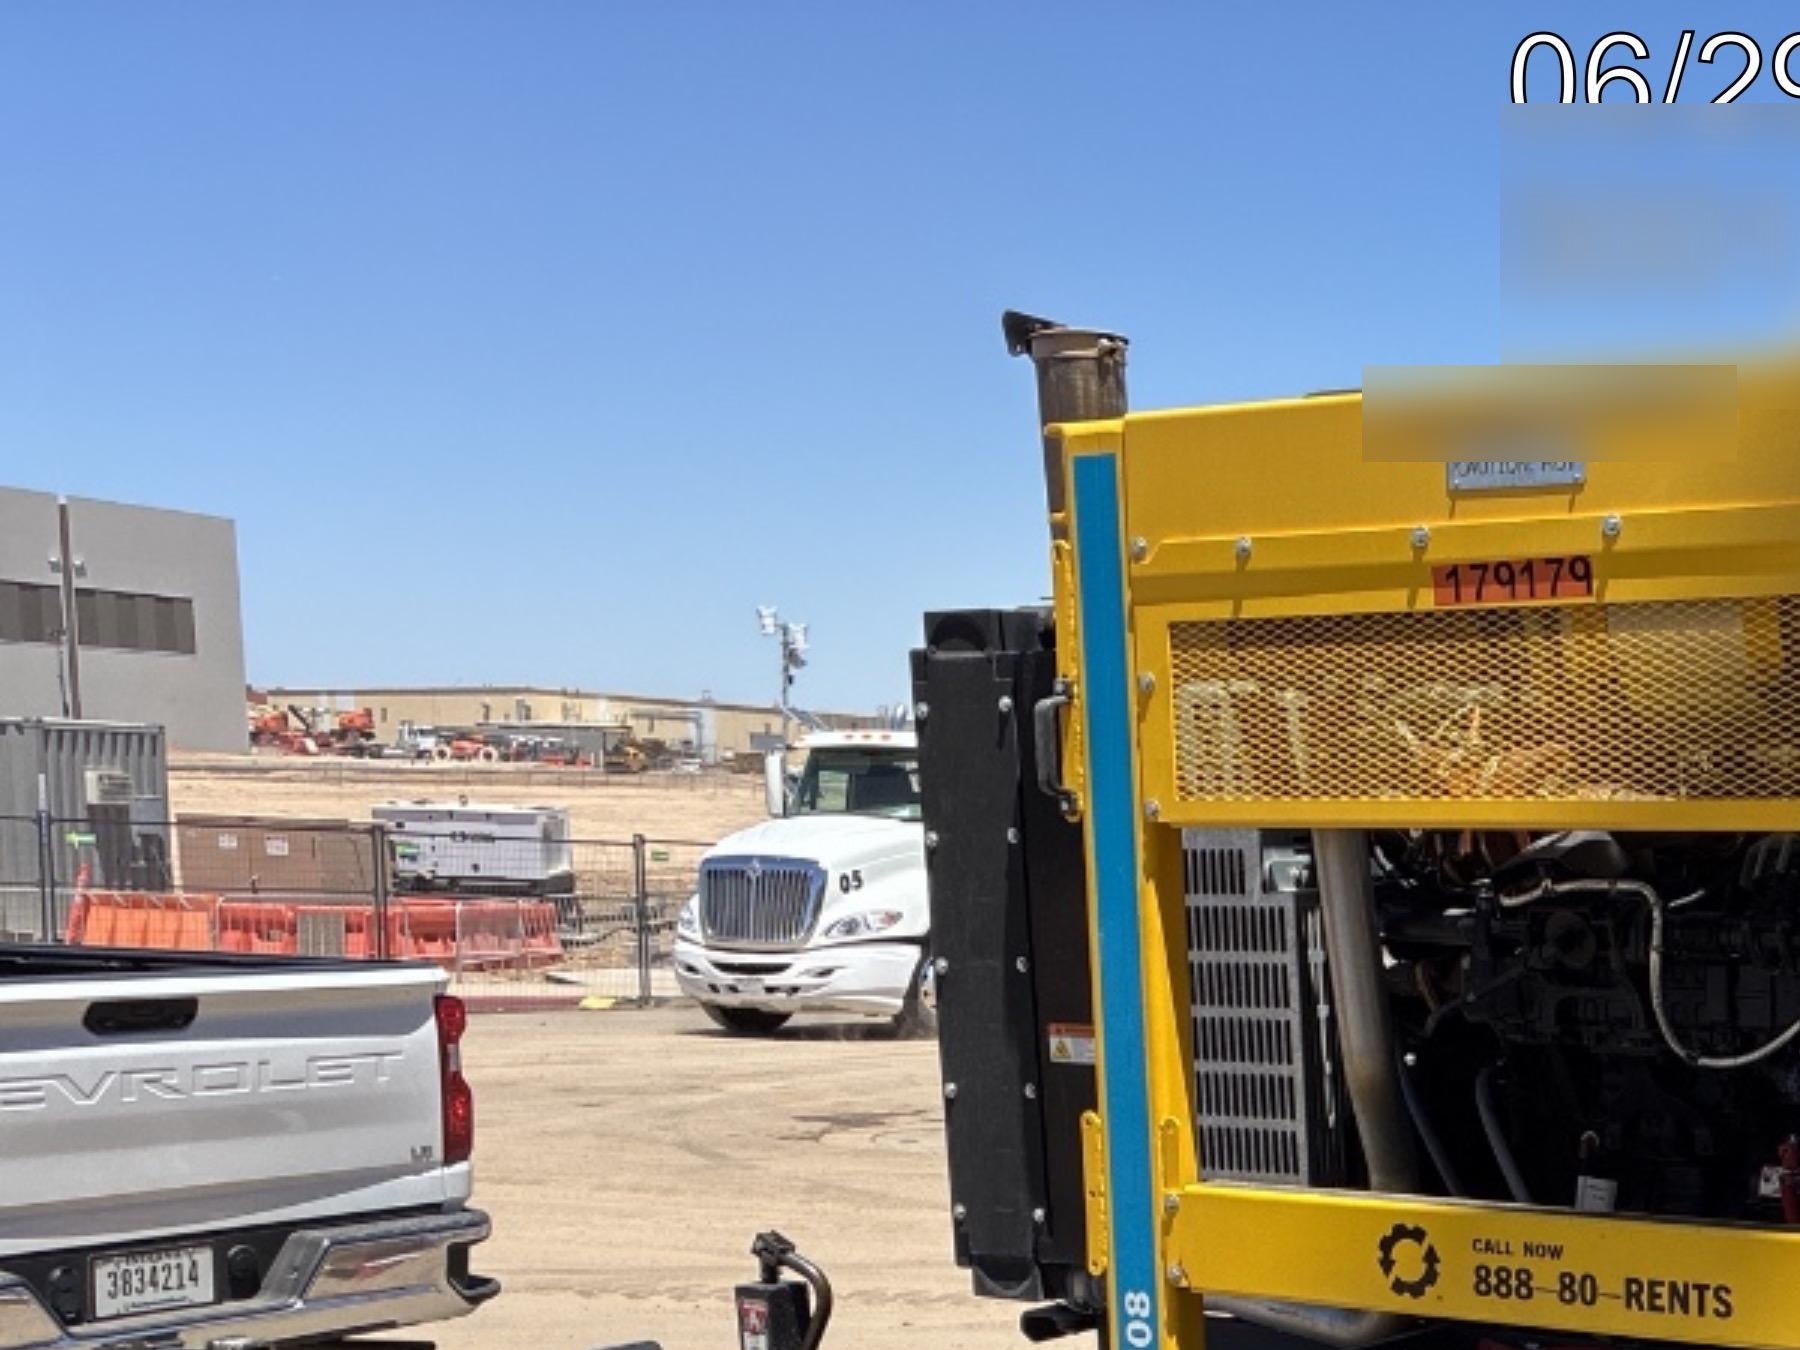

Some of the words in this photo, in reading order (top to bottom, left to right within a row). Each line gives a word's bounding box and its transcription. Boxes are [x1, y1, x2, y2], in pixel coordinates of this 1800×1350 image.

[1445, 555, 1593, 602] 179179
[1472, 1238, 1514, 1255] CALL
[1523, 1241, 1564, 1260] NOW
